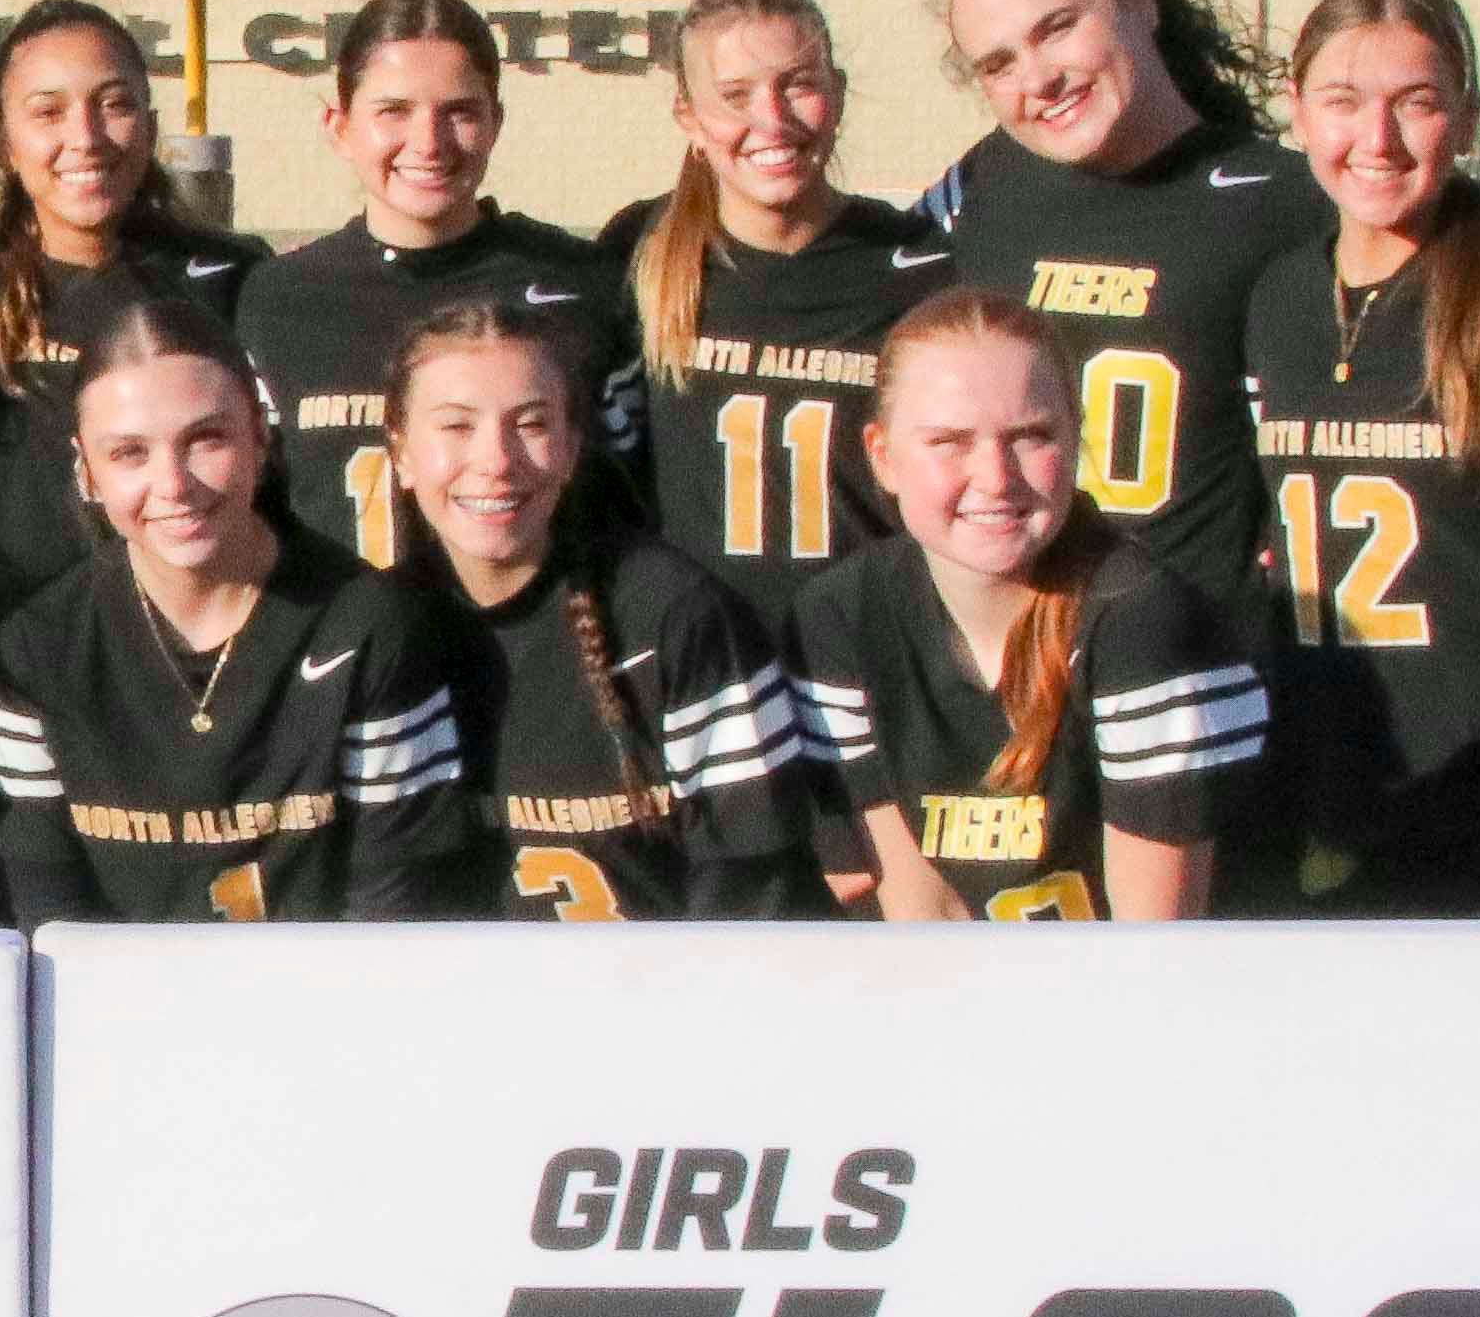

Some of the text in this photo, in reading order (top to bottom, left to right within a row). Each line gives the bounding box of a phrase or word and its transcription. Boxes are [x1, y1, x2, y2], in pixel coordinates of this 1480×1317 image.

[1026, 260, 1157, 316] TIGERS
[694, 336, 879, 387] RTH ALLEGHE
[1256, 420, 1306, 457] RTH
[717, 393, 834, 559] 11
[1278, 472, 1432, 646] 12
[70, 803, 173, 844] NORTH
[508, 785, 671, 834] ALLEGHEY
[920, 794, 1047, 861] TIGERS
[531, 1147, 916, 1252] GIRLS
